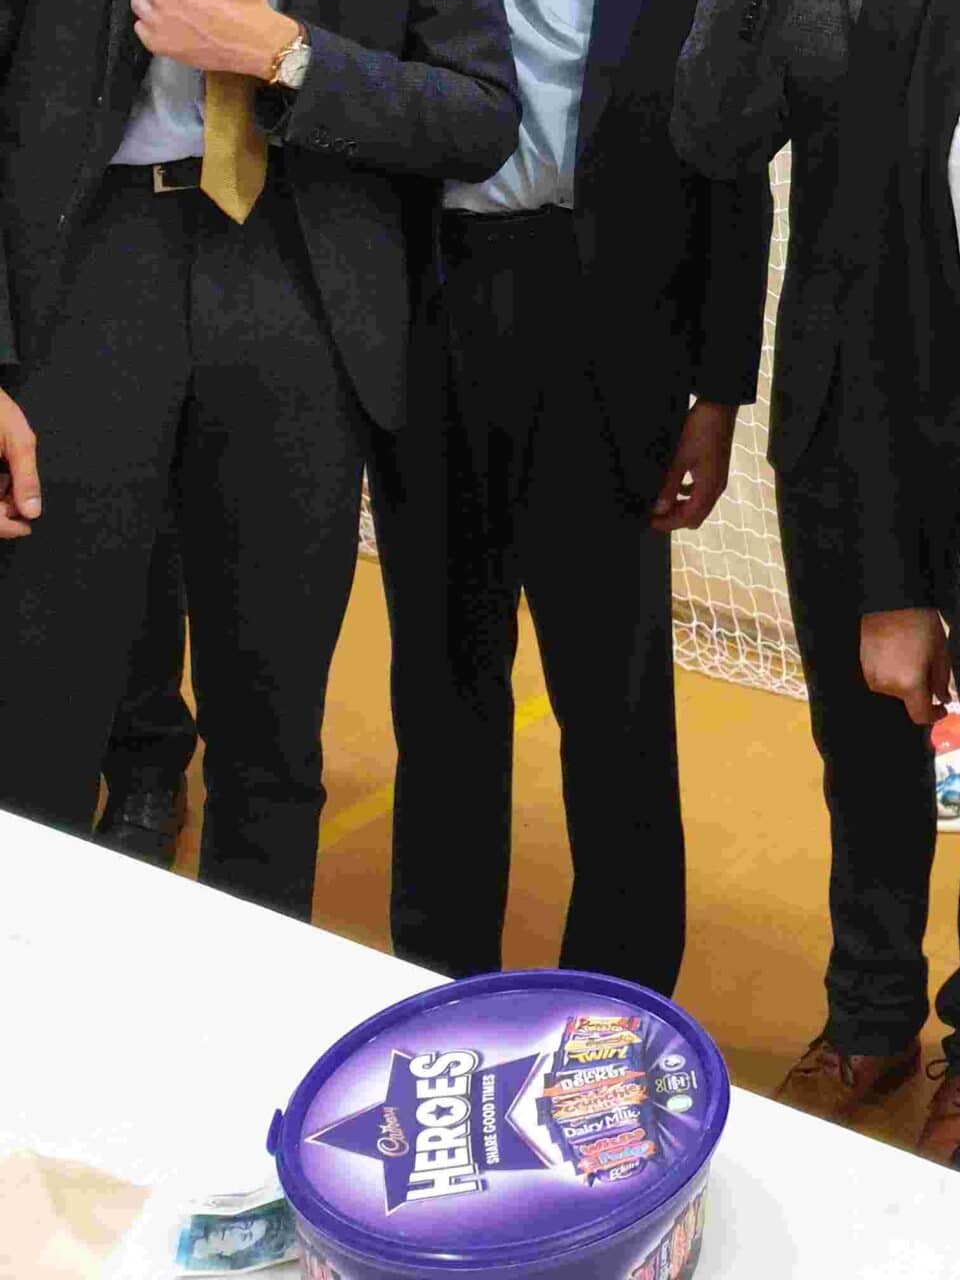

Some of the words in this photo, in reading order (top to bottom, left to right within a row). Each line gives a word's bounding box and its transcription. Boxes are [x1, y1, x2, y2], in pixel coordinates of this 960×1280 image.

[481, 1073, 496, 1101] TIMES
[406, 1048, 484, 1201] HEROES
[482, 1102, 497, 1133] GOOD
[563, 1119, 604, 1138] Dairy
[483, 1133, 501, 1165] SHARE
